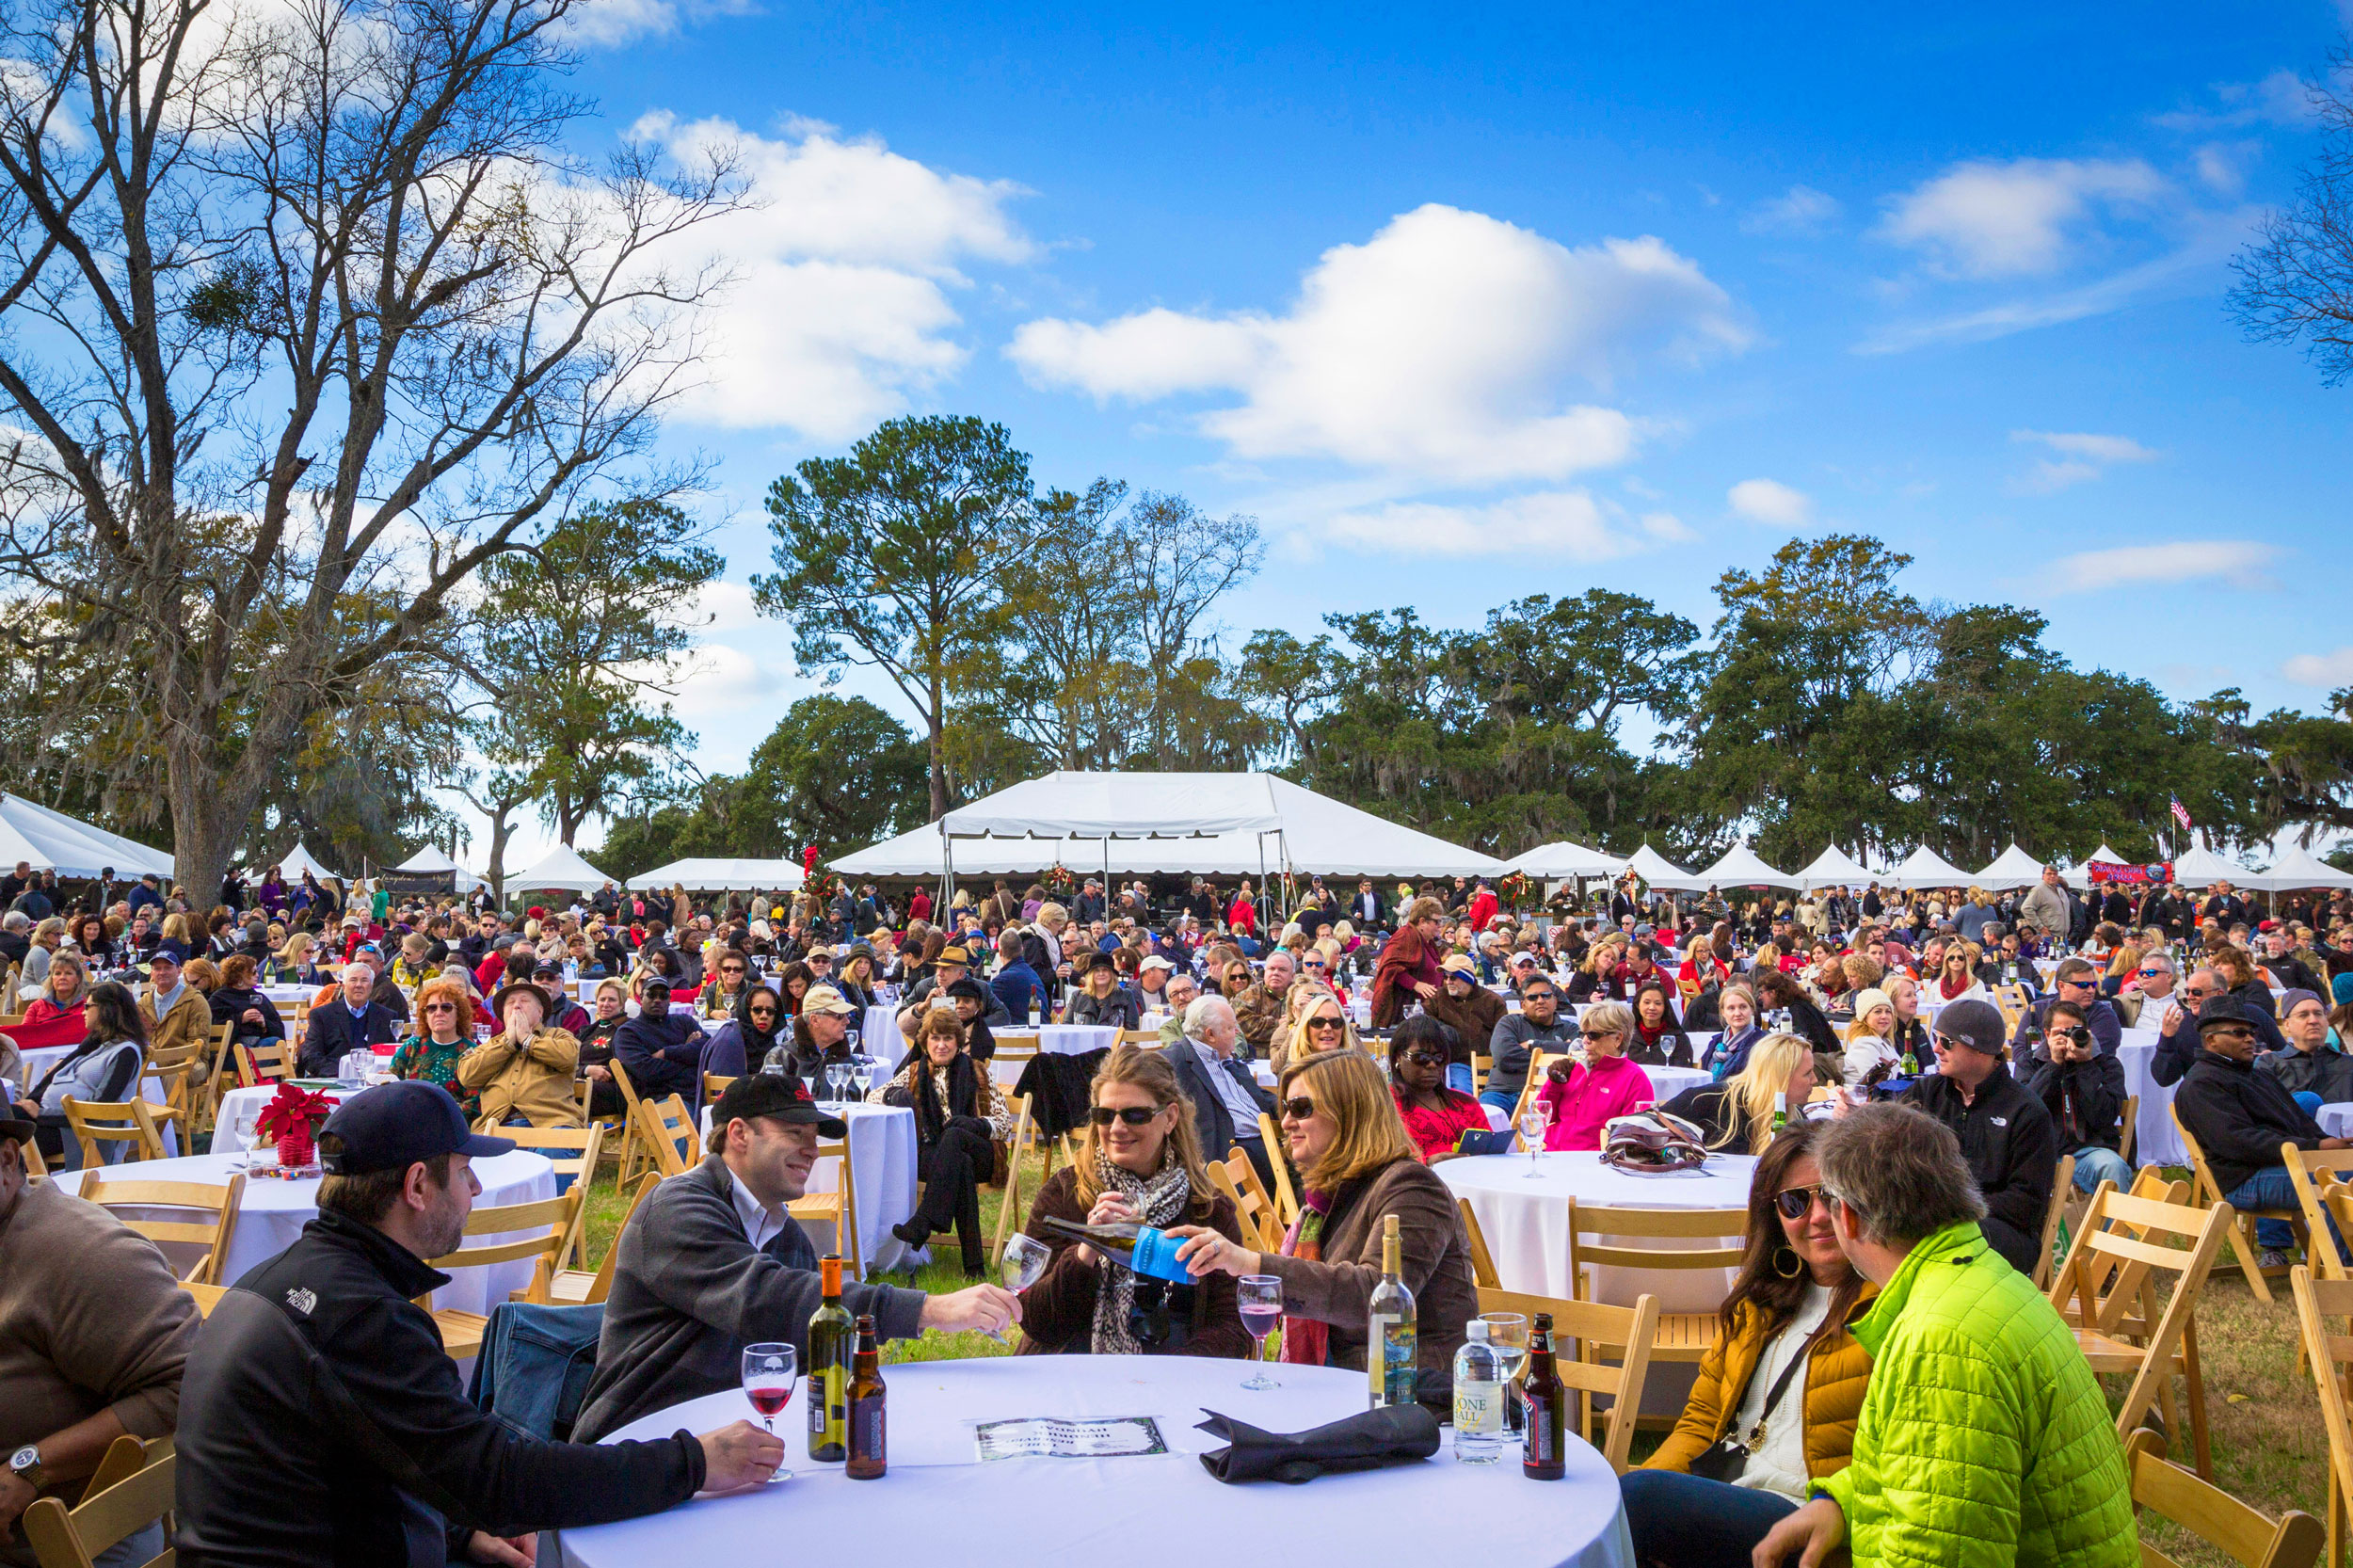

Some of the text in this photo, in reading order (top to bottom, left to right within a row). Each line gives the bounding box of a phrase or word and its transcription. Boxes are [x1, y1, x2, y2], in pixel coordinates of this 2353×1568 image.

[285, 1288, 308, 1304] NORTH
[300, 1287, 312, 1298] THE
[285, 1296, 303, 1310] FACE
